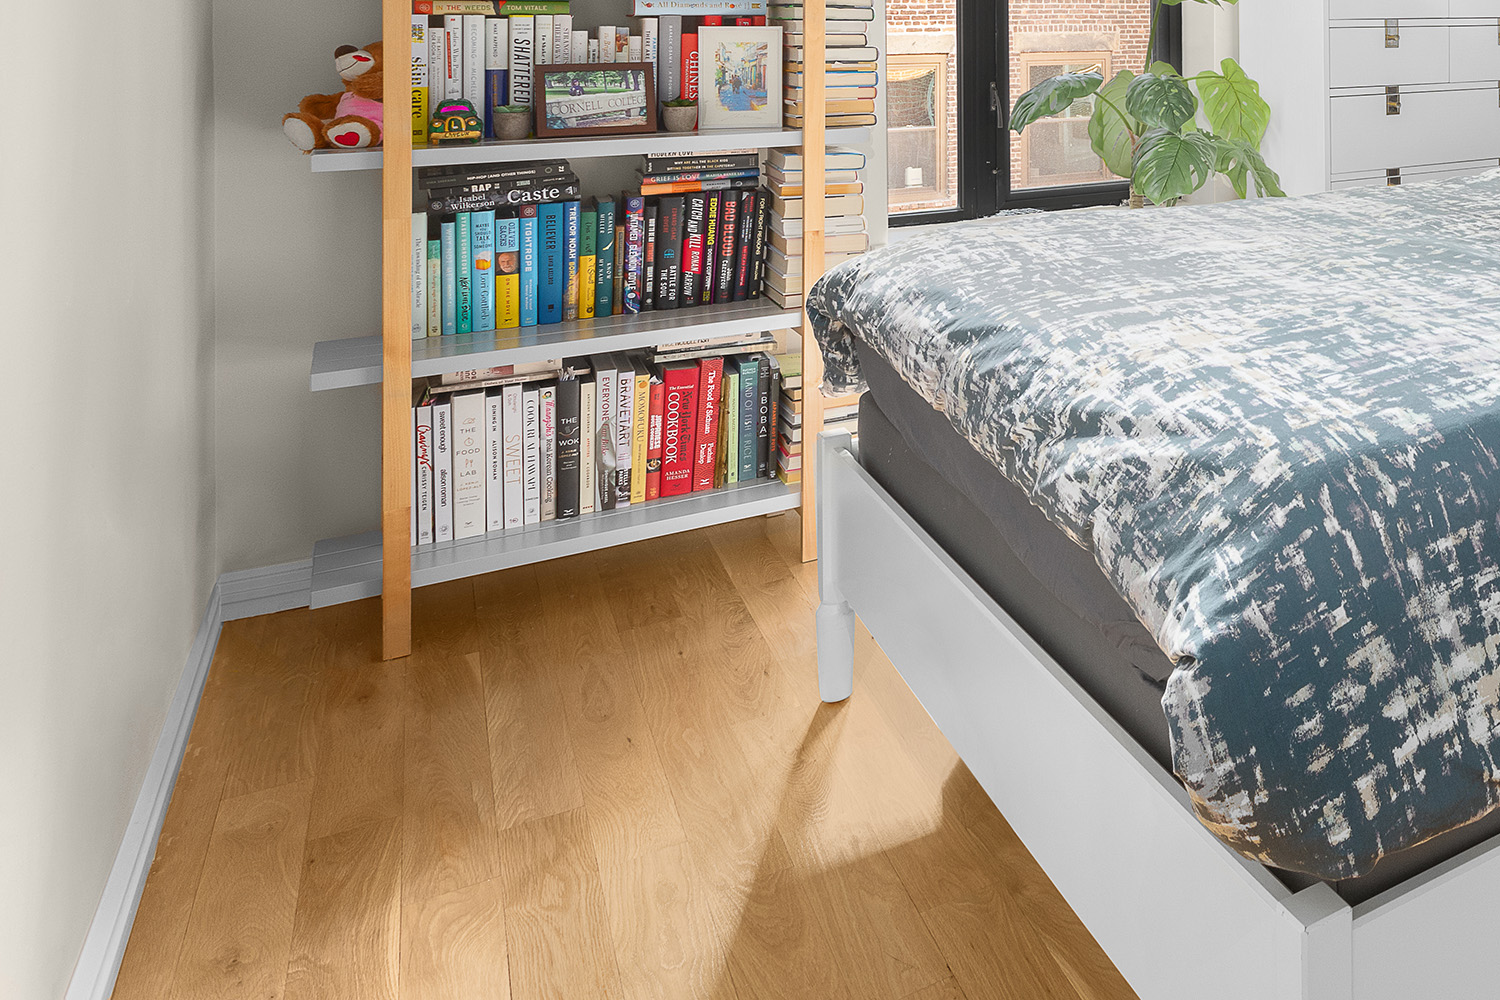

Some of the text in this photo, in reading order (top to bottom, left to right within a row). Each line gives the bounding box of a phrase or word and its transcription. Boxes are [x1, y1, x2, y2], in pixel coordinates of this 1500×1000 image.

[470, 24, 478, 59] BECOMING
[514, 38, 530, 104] SHATTERED
[689, 51, 698, 101] CHINES
[412, 89, 422, 119] care
[551, 100, 603, 116] CORNELL
[459, 194, 487, 203] Isabel
[471, 183, 492, 193] RAP
[506, 187, 560, 204] Caste
[450, 200, 496, 210] Wilkerson
[508, 222, 516, 248] OLIVER
[546, 214, 556, 250] BELIEVER
[568, 206, 577, 259] TREVOR NOAH
[630, 213, 638, 240] UNTAMED
[706, 198, 718, 246] EDDIE HUANG
[722, 201, 736, 256] BAD BLOOD
[524, 222, 532, 272] TIGHTROPE
[684, 198, 704, 296] CATCH AND KILL RONAN FARROW
[660, 268, 668, 280] THE
[480, 272, 490, 320] Lori Gottlieb
[668, 286, 676, 301] FOR
[602, 377, 610, 422] EVERYONE
[681, 390, 693, 410] New
[744, 378, 753, 398] LAND
[618, 379, 632, 446] BRAVETART
[704, 370, 716, 434] The Food of Sichuan
[744, 400, 752, 412] OF
[438, 410, 446, 431] sweet
[636, 392, 645, 442] MOMOFUKU
[665, 392, 680, 464] COOKBOOK
[680, 412, 692, 434] York
[416, 424, 434, 472] Cravings
[456, 448, 481, 456] FOOD
[558, 438, 580, 446] WOK
[698, 444, 706, 464] Dunlop
[706, 442, 714, 464] Fuchsia
[744, 440, 752, 460] RICE
[505, 434, 521, 485] SWEET
[460, 469, 477, 478] LAB
[665, 469, 690, 477] AMANDA
[440, 486, 448, 508] roman
[544, 476, 554, 504] Cooking
